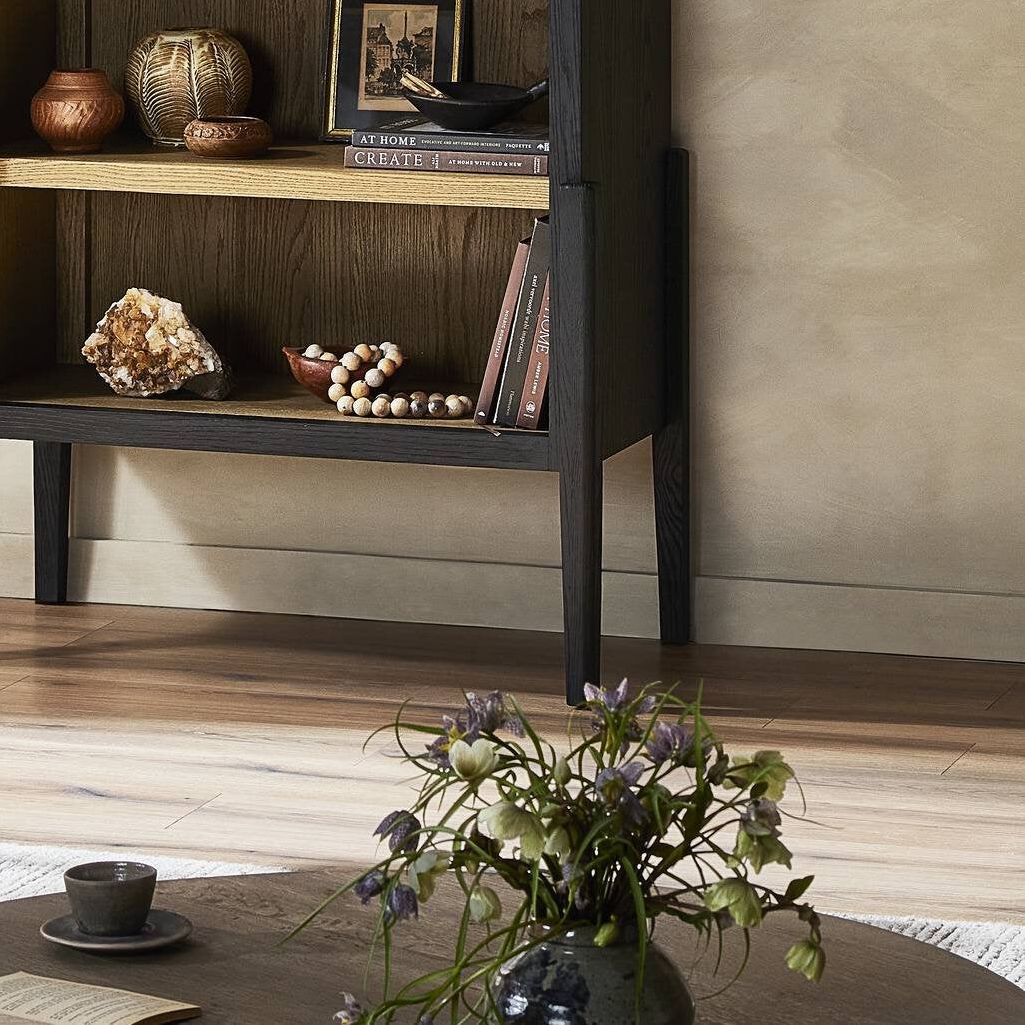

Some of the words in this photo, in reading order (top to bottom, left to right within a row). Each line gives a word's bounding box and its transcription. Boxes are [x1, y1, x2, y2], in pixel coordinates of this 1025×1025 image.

[360, 135, 376, 144] AT
[379, 135, 417, 146] HOME
[354, 151, 423, 167] CREATE
[535, 361, 543, 379] AMBER
